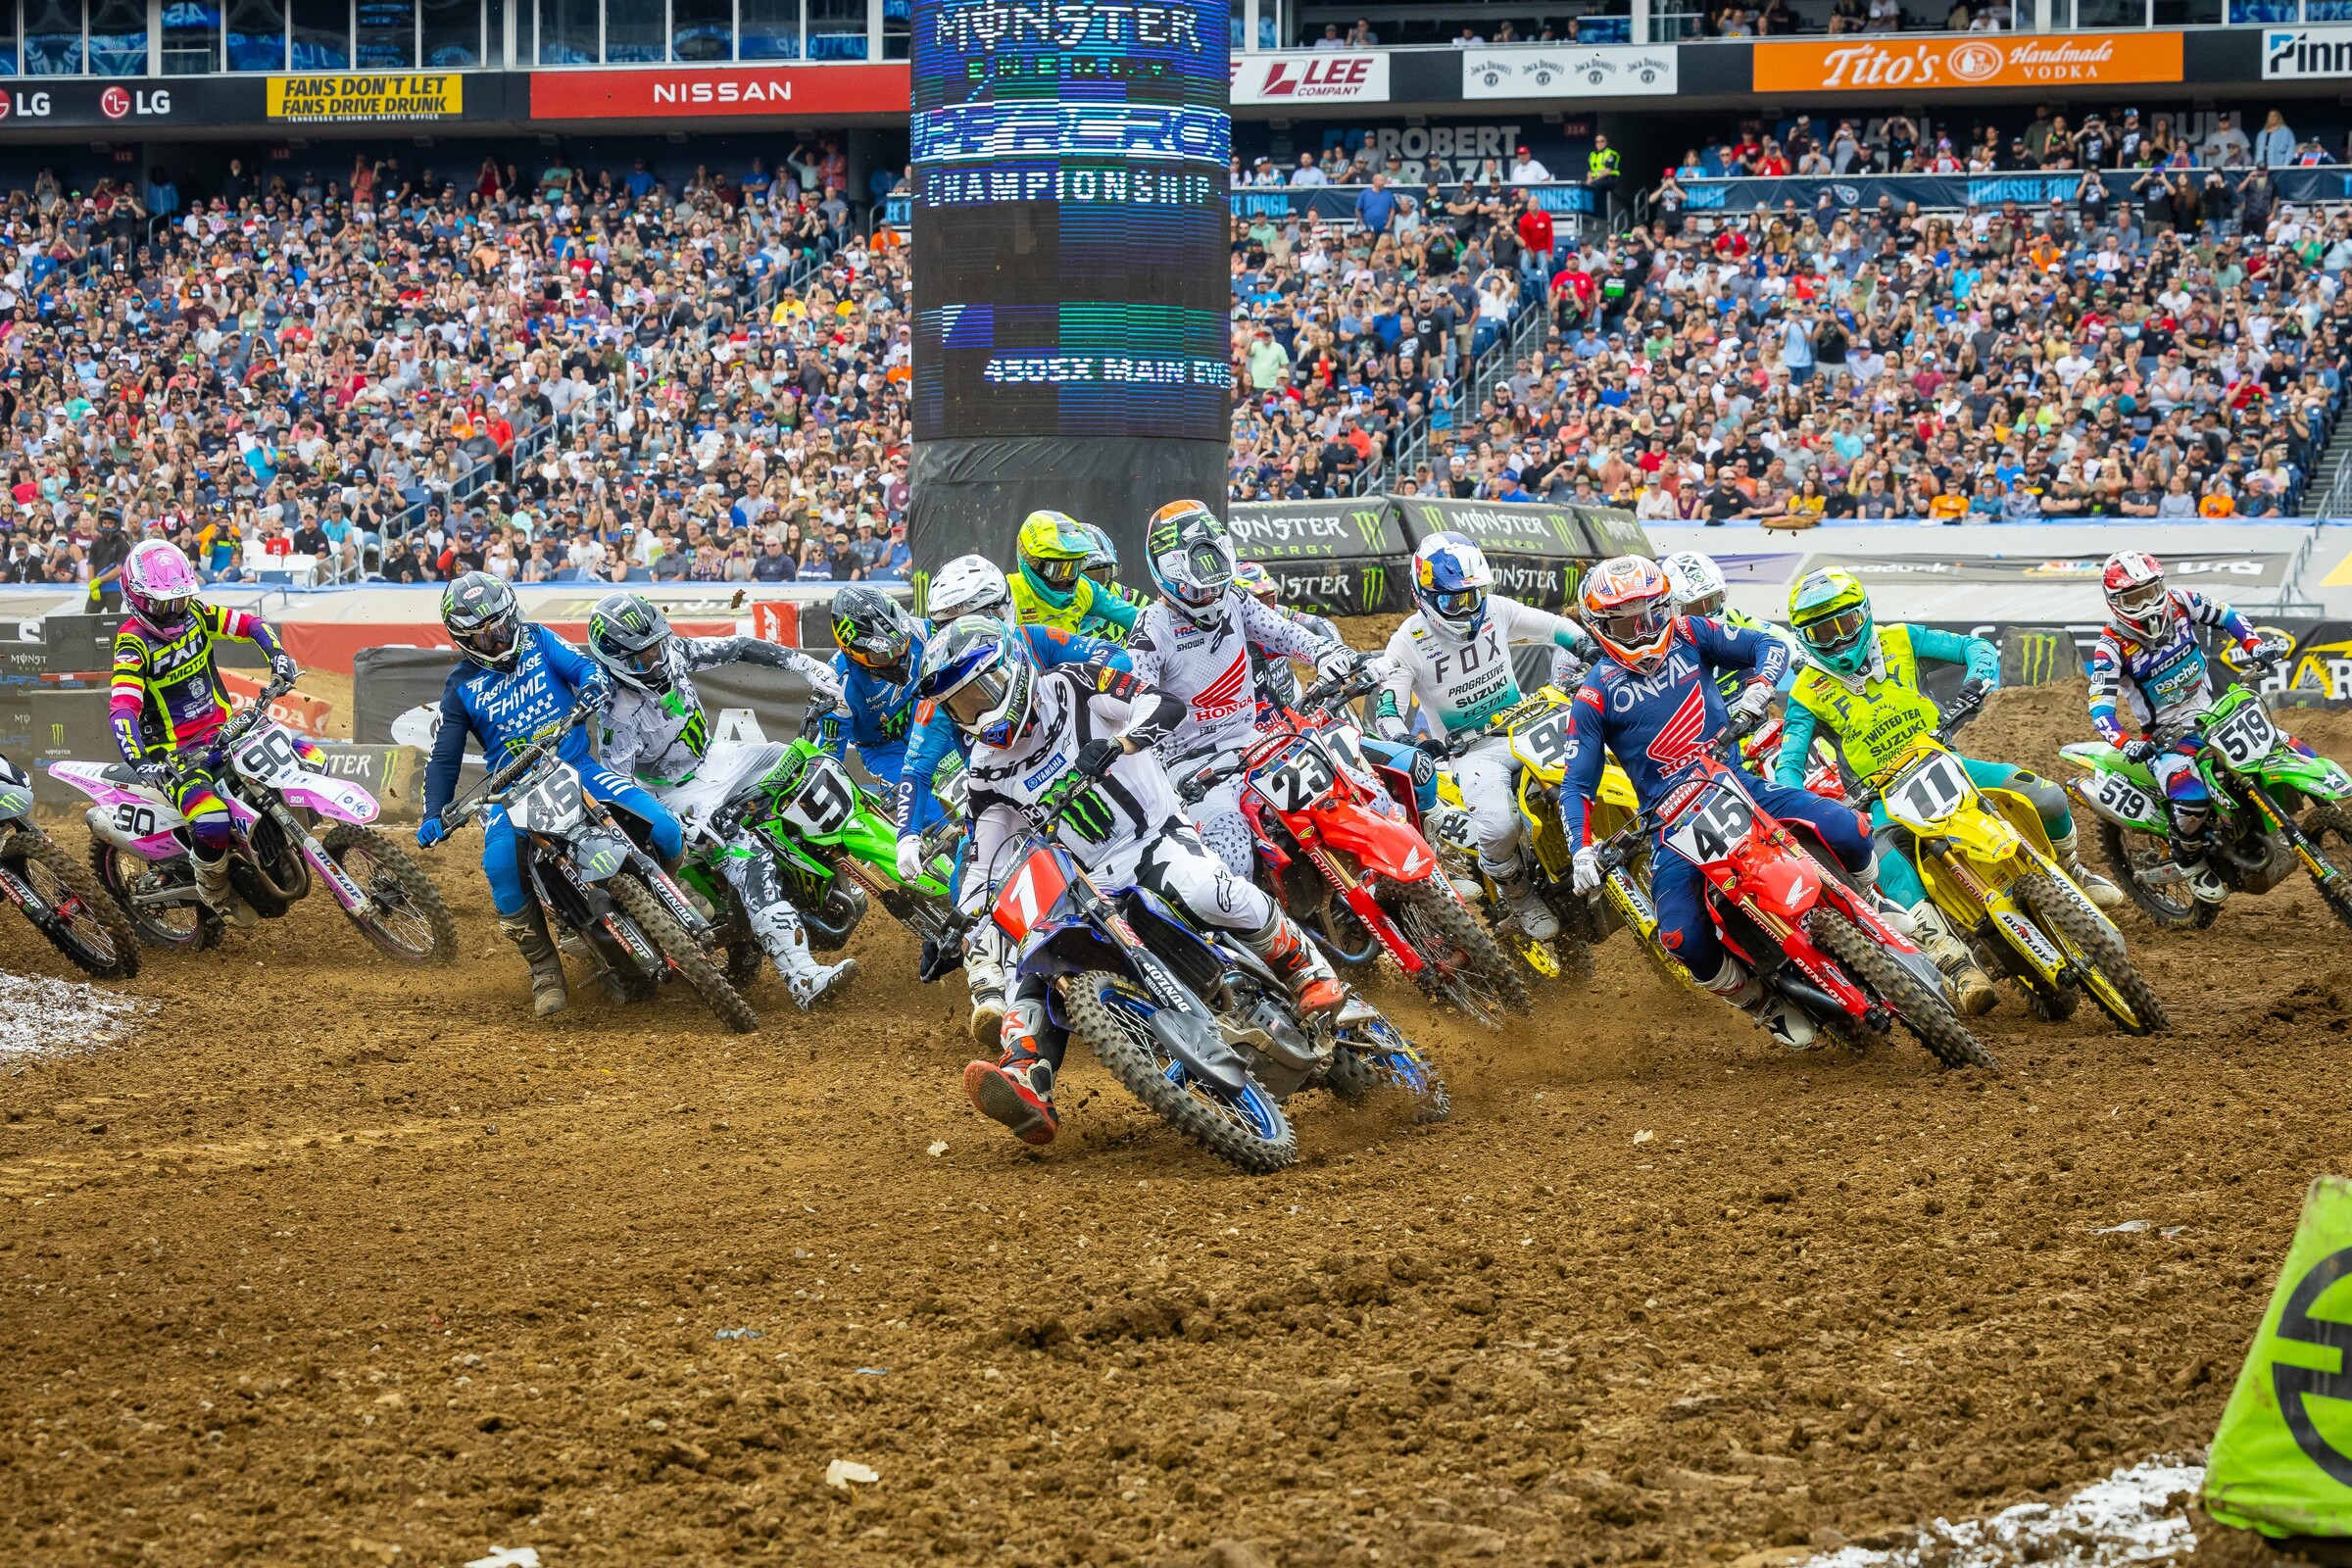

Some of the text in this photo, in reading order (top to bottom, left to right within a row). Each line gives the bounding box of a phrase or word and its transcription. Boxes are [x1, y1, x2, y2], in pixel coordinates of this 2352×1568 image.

[938, 5, 1201, 50] MONSTER
[2009, 39, 2114, 65] Handmade
[285, 76, 447, 96] FANS DON'T LET
[1302, 58, 1374, 84] LEE
[2023, 65, 2099, 79] VODKA
[17, 92, 50, 116] LG
[136, 90, 171, 114] LG
[282, 96, 447, 114] FANS DRIVE DRUNK
[654, 81, 792, 102] NISSAN
[1298, 85, 1362, 97] COMPANY
[1377, 125, 1522, 160] ROBERT
[927, 171, 1211, 207] CHAMPIONSHIP
[1967, 178, 2041, 204] TENNESSEE
[1103, 358, 1185, 383] MAIN
[1229, 509, 1348, 542] ONSTER
[1451, 510, 1551, 537] MONSTER
[1236, 544, 1333, 557] ENERGY
[1479, 537, 1544, 550] ENERGY
[1173, 625, 1200, 637] HRC
[1176, 638, 1205, 653] SHOWA
[152, 627, 204, 675] FXR
[170, 653, 205, 683] MOTO
[276, 654, 289, 673] FXR
[1434, 629, 1501, 684] FOX
[2150, 644, 2192, 678] MOTO
[808, 662, 831, 684] FOX
[1012, 663, 1028, 708] MONSTER
[1448, 661, 1506, 698] PROGRESSIVE
[2154, 661, 2199, 695] psychic
[1195, 694, 1254, 723] HONDA
[1455, 675, 1508, 709] SUZUKI
[1463, 690, 1509, 718] ECSTAR
[1832, 664, 1905, 722] FLY
[114, 718, 142, 760] FXR
[1862, 714, 1902, 750] TWISTED
[1901, 708, 1922, 724] TEA
[1869, 718, 1928, 758] SUZUKI
[2217, 709, 2270, 763] 519
[135, 762, 167, 774] FXR
[241, 729, 293, 779] 90
[328, 754, 372, 779] TER
[1036, 756, 1065, 786] YAMAHA
[1657, 738, 1718, 780] HOND
[71, 776, 97, 790] DUNLOP
[1271, 743, 1335, 815] 23
[1657, 770, 1698, 812] RENTHAL
[1904, 760, 1959, 820] 11
[799, 767, 853, 833] 9
[1310, 791, 1331, 807] HONDA
[1665, 776, 1708, 817] RENTHAL
[2098, 782, 2146, 820] 519
[114, 802, 155, 836] 90
[1691, 790, 1753, 863] 45
[1728, 836, 1748, 856] HONDA
[314, 849, 364, 903] DUNLOP
[1406, 857, 1433, 878] HONDA
[650, 875, 696, 923] DUNLOP
[662, 874, 691, 906] MOTUL
[1009, 861, 1041, 932] 1
[1789, 886, 1815, 909] HONDA
[1952, 867, 1985, 906] SHOW
[2052, 875, 2099, 920] DUNLOP
[605, 910, 651, 960] DUNLOP
[606, 923, 633, 955] MOTUL
[1358, 913, 1405, 968] DUNLOP
[1854, 900, 1911, 948] DUNLOP
[2001, 913, 2054, 964] DUNLOP
[1143, 961, 1193, 1013] DUNLOP
[1793, 956, 1848, 1007] DUNLOP
